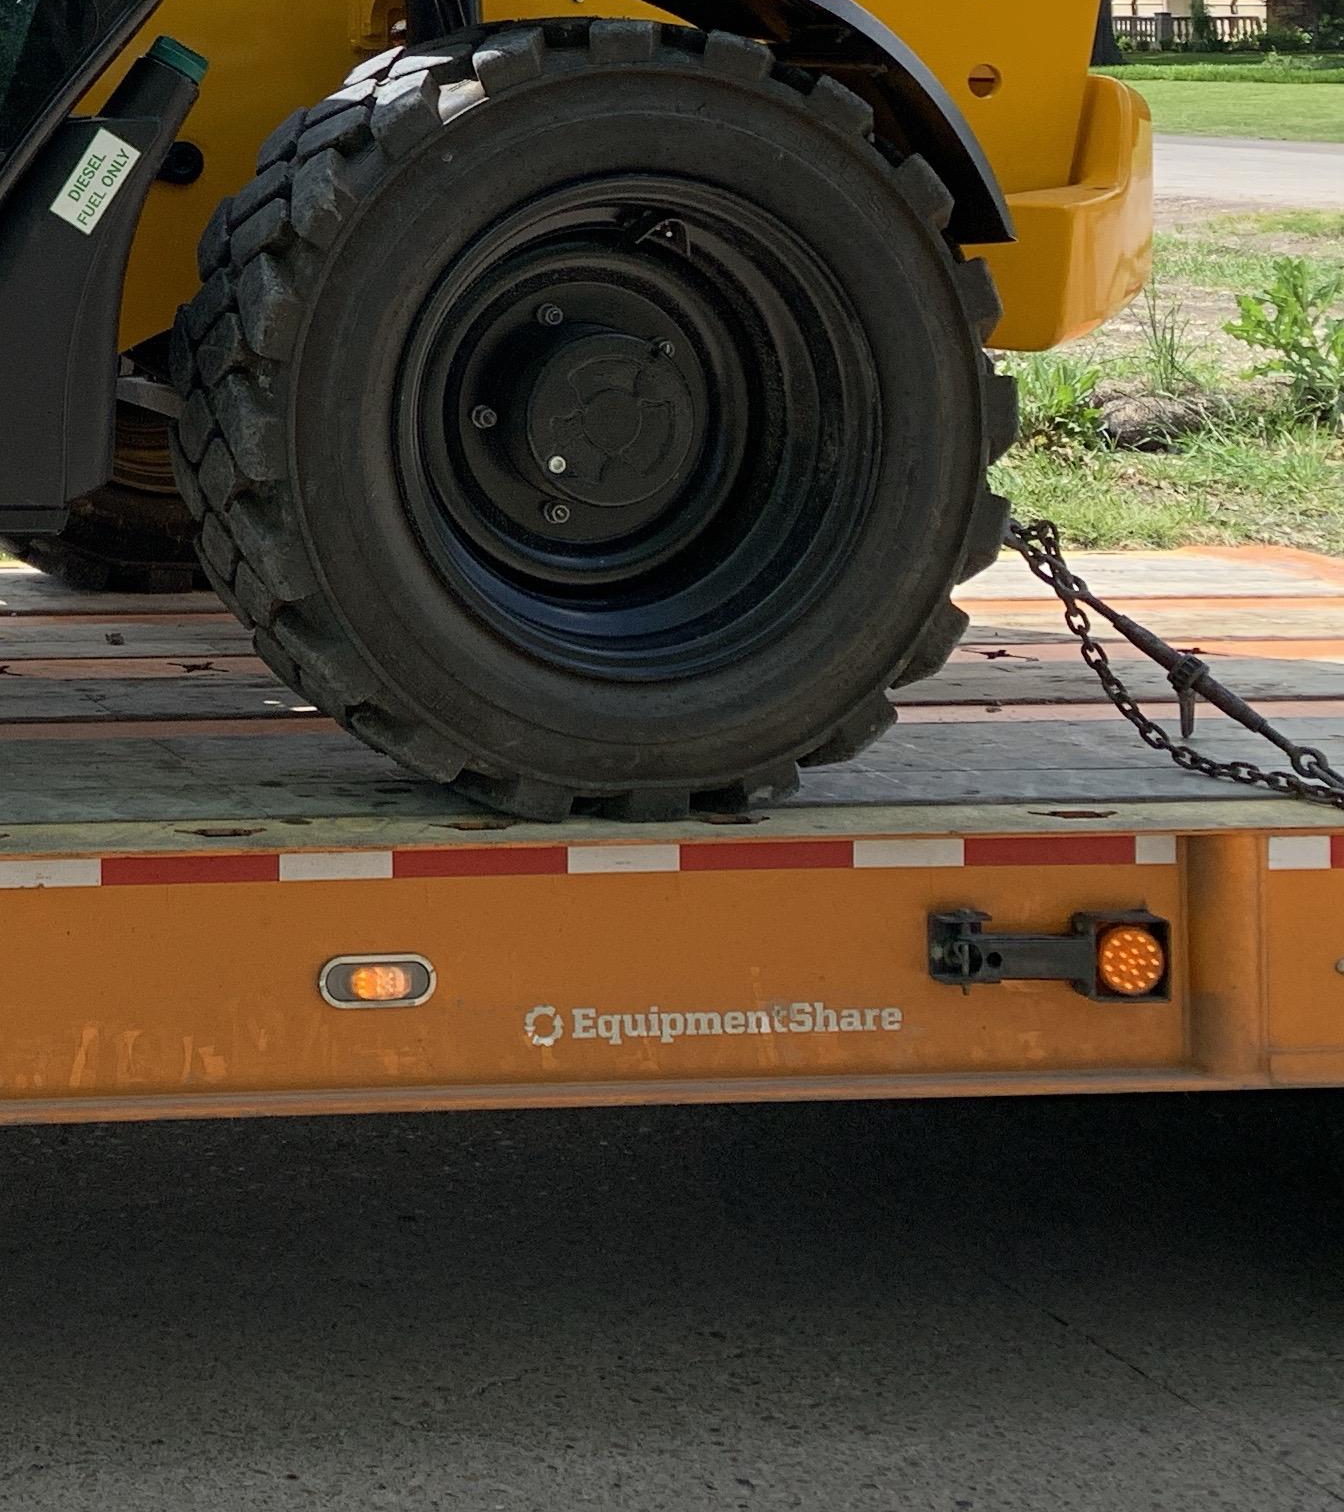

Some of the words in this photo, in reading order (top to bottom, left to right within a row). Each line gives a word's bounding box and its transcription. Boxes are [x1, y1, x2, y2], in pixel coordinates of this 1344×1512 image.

[67, 153, 108, 202] DIESEL
[77, 191, 107, 227] FUEL
[101, 147, 131, 188] ONLY
[570, 1000, 903, 1045] EquipmentShare
